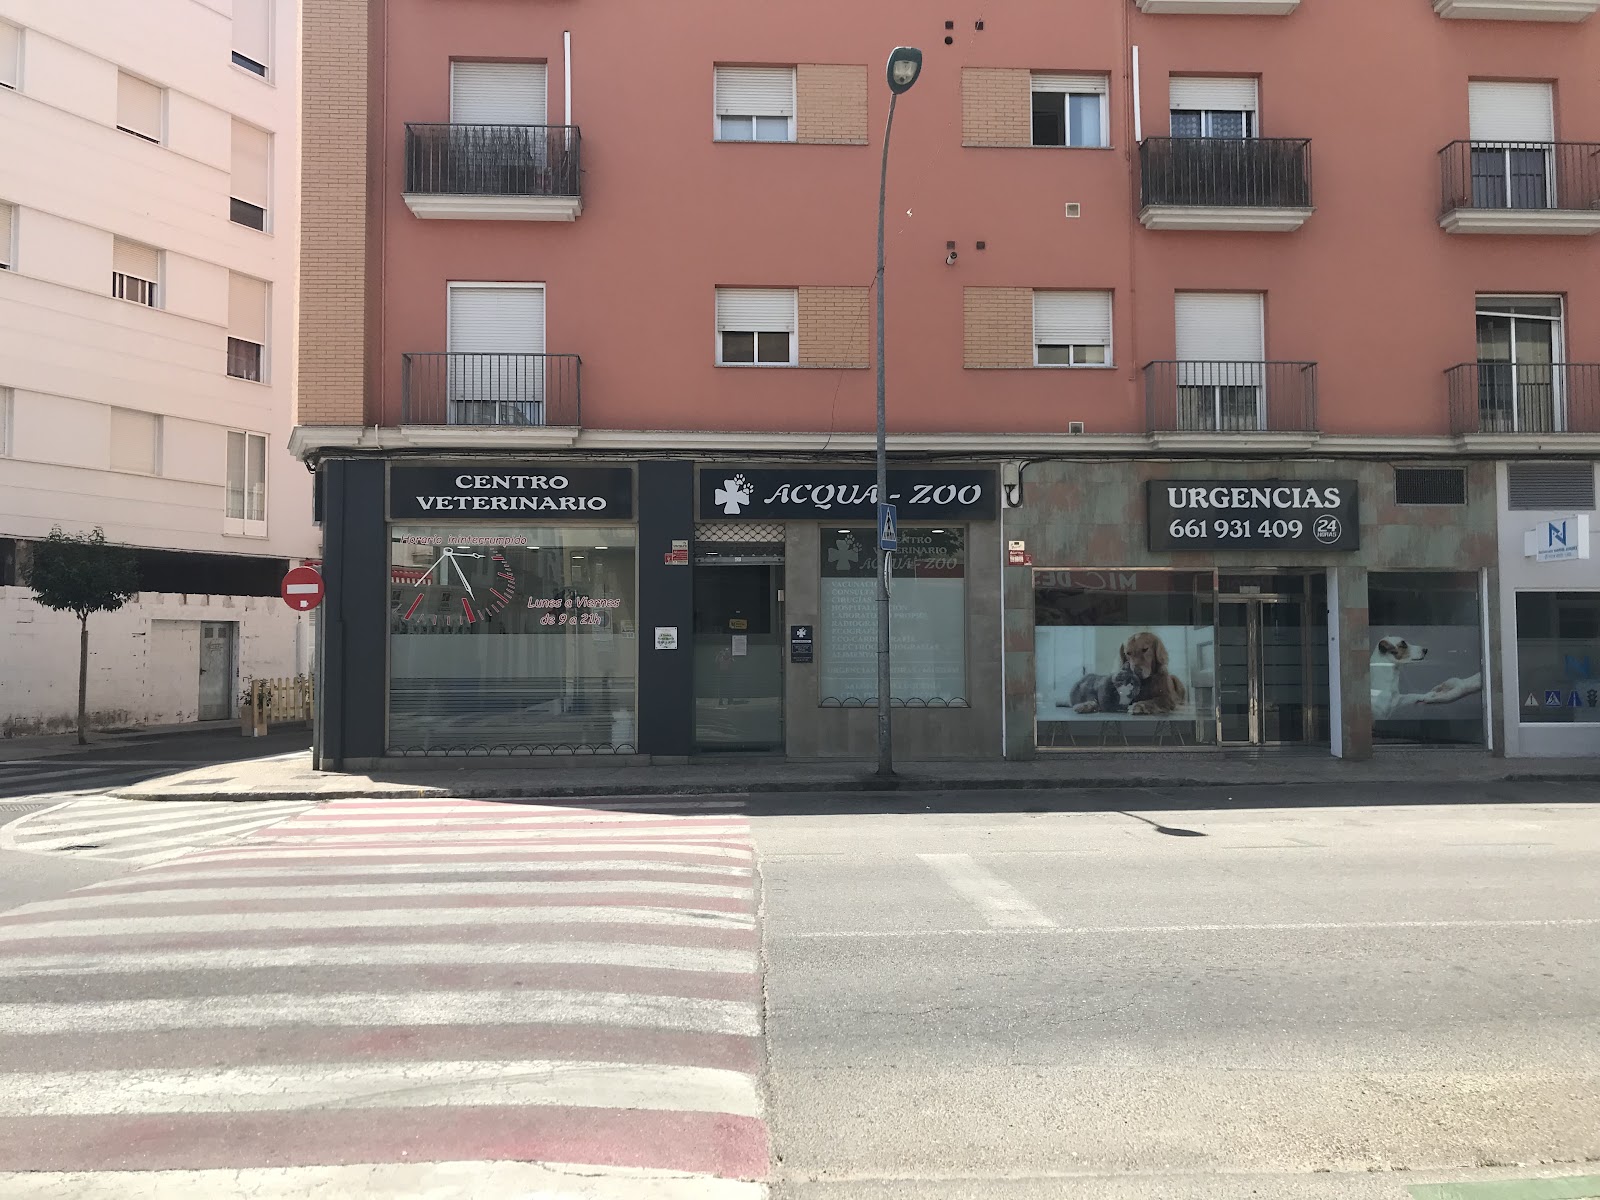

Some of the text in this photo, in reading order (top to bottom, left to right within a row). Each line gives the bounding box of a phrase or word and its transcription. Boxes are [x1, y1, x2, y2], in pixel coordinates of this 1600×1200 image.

[455, 475, 568, 489] CENTRO
[416, 496, 607, 511] VETERINARIO
[763, 484, 878, 510] ACQUA
[908, 484, 982, 505] ZOO
[1167, 486, 1341, 508] URGENCIAS
[1169, 519, 1303, 538] 661 931 409
[1317, 519, 1337, 532] 24
[400, 533, 528, 548] Horario ininterrumpido
[895, 536, 933, 544] ENTRO
[873, 546, 948, 554] VERINARIO
[527, 596, 621, 608] Lunes a Viernes
[539, 612, 602, 625] de 9 a 21h
